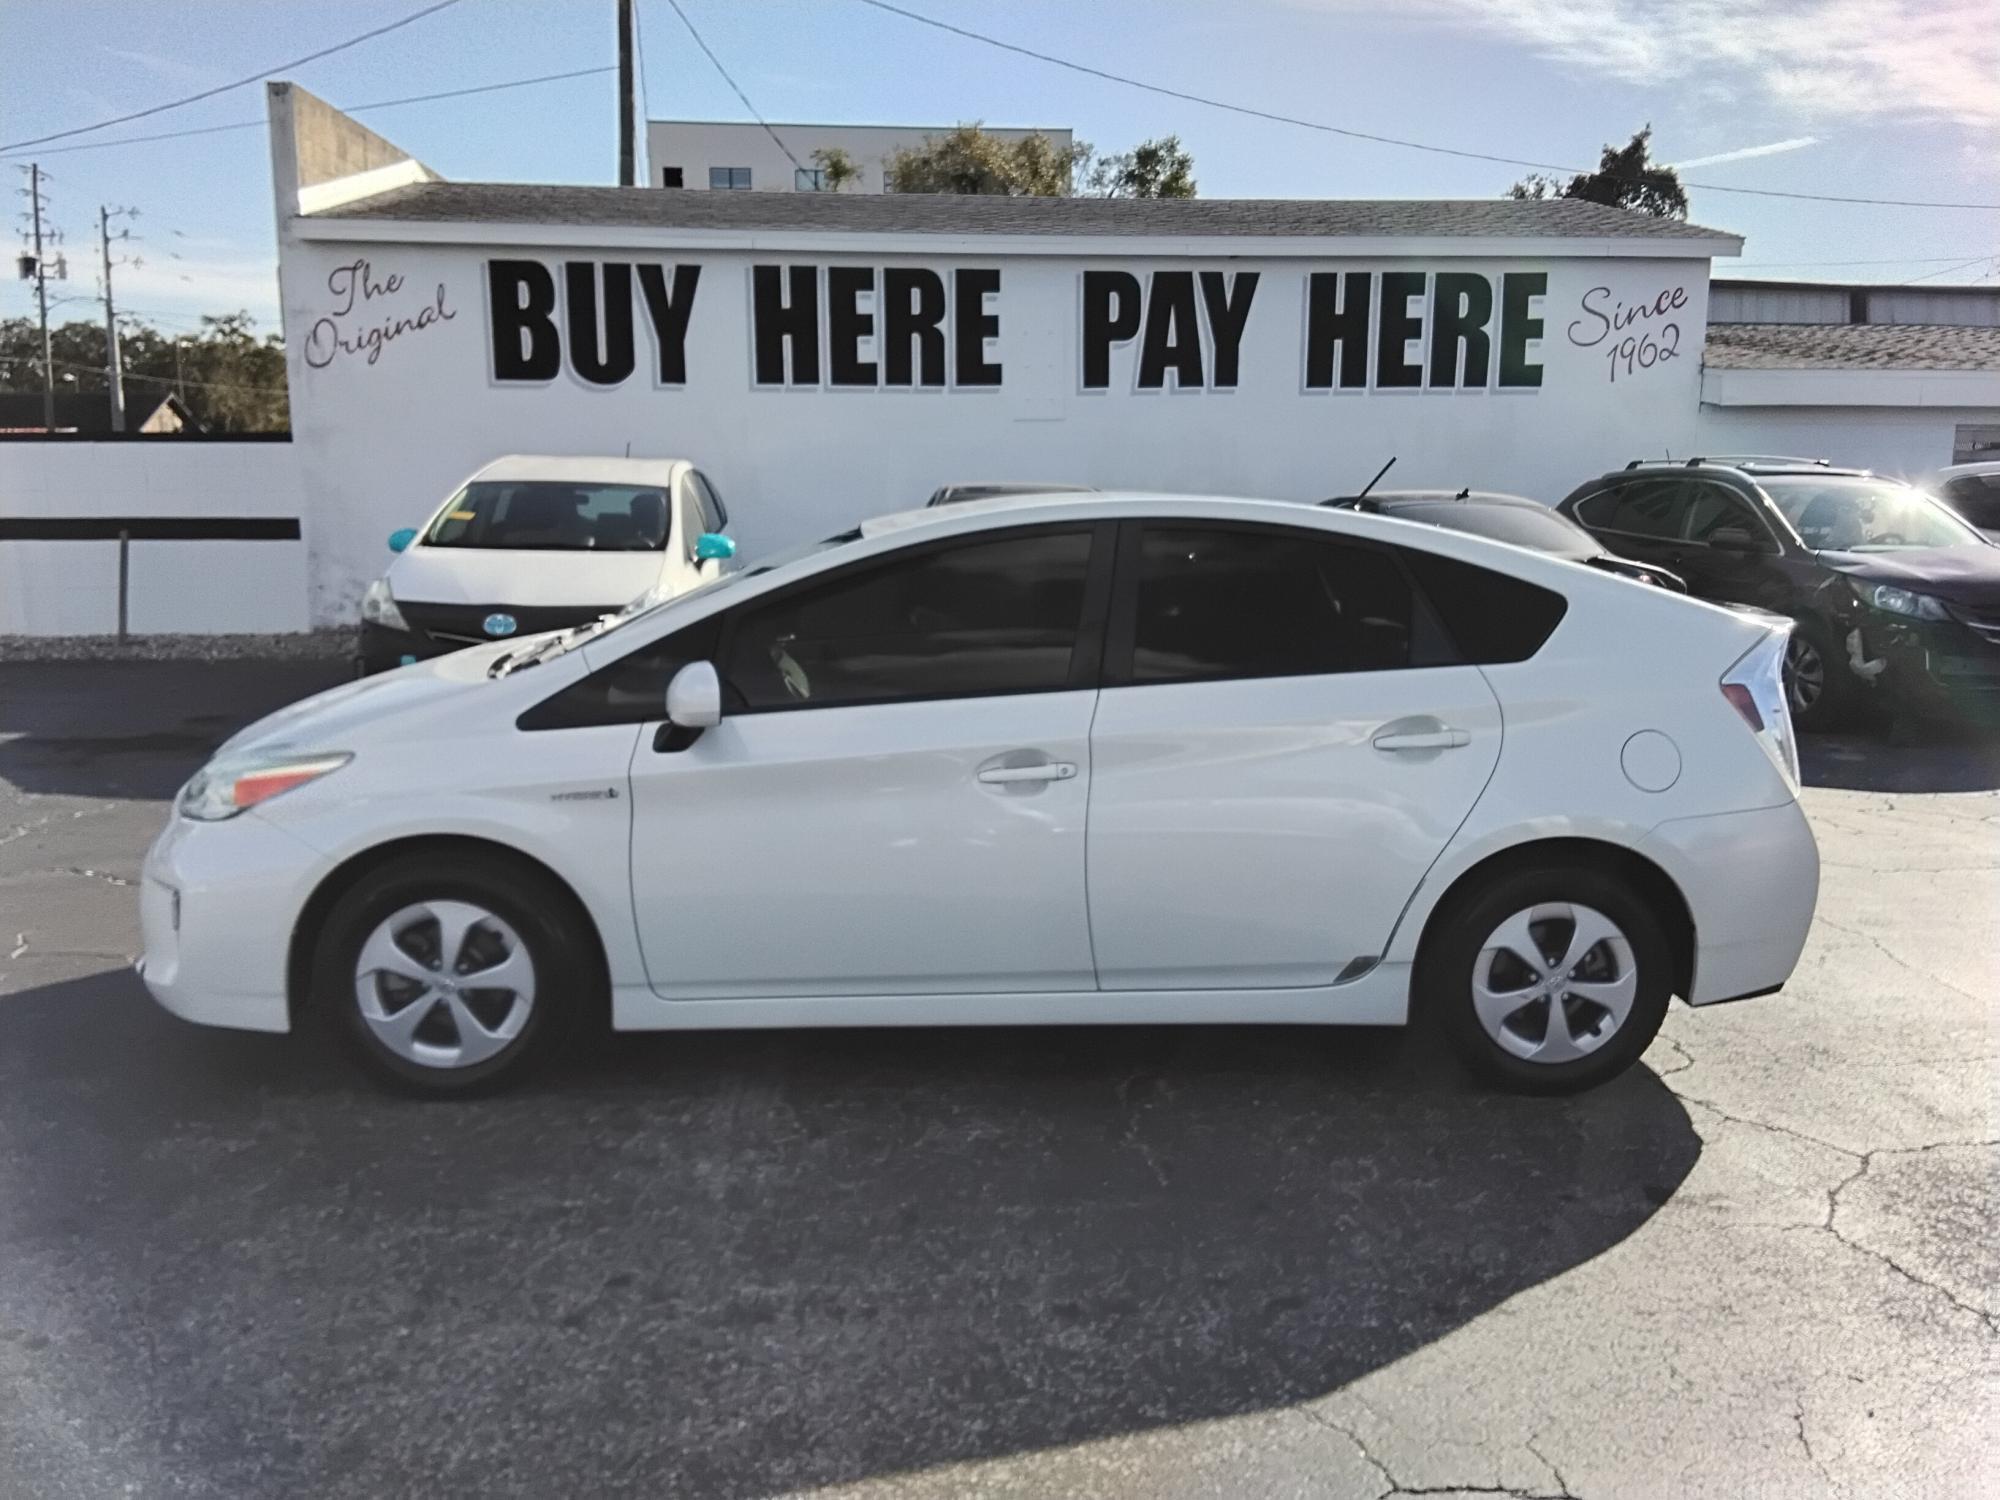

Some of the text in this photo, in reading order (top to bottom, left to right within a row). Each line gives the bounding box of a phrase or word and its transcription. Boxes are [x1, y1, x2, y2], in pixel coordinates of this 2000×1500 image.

[328, 258, 405, 317] The
[1567, 286, 1688, 347] Since
[304, 283, 457, 369] Original
[488, 258, 1548, 389] BUY HERE PAY HERE
[1606, 323, 1680, 382] 1962
